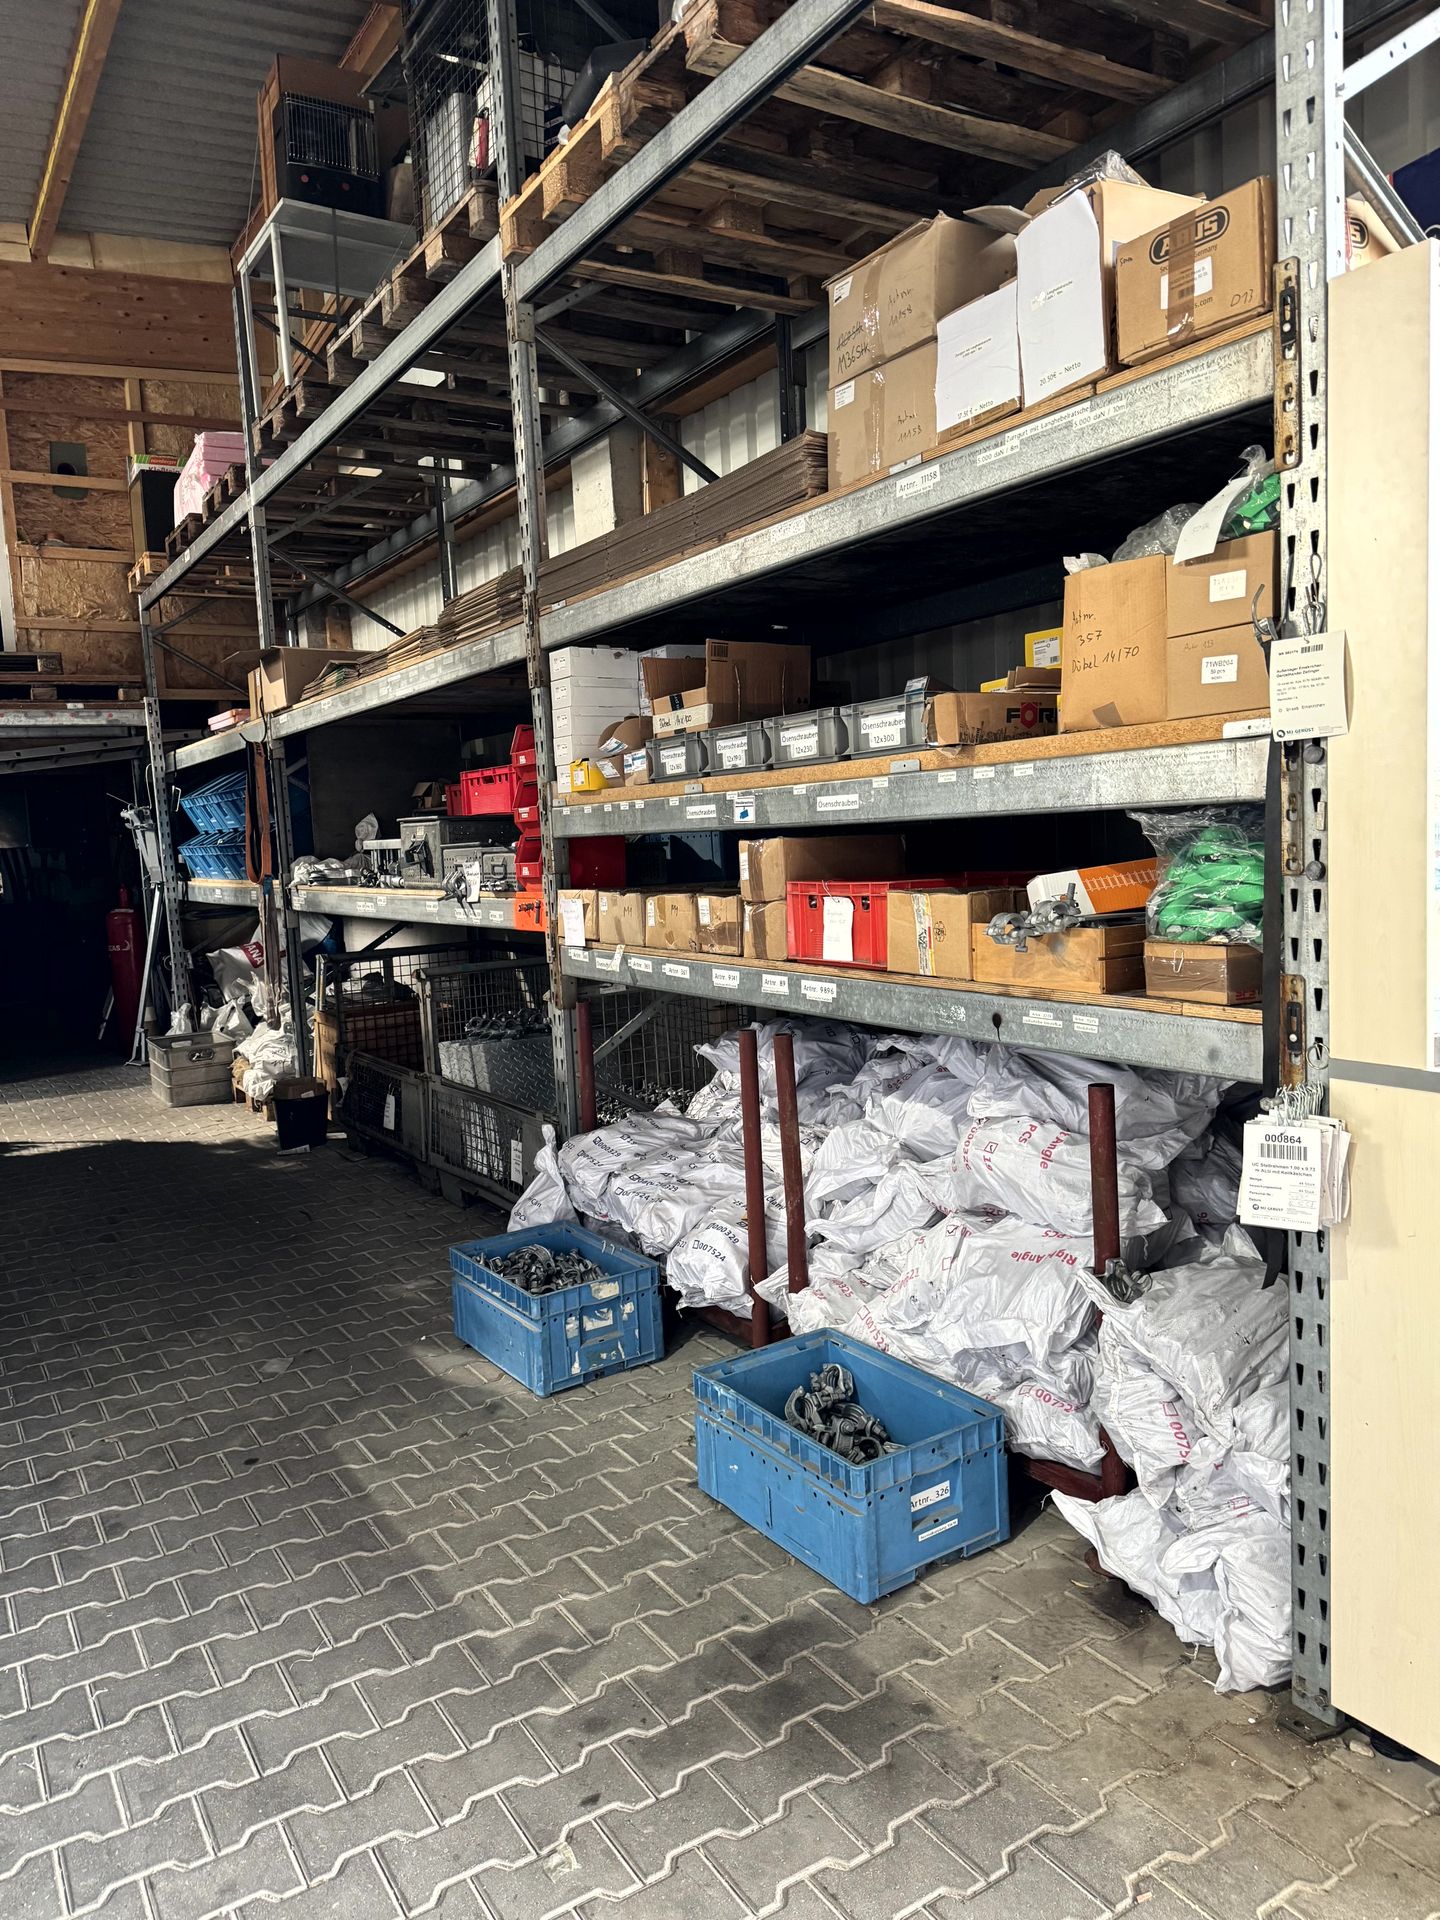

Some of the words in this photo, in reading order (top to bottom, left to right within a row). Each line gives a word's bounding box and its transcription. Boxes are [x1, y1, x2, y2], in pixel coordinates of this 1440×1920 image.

[1160, 214, 1218, 256] ABUS
[1064, 361, 1082, 373] Netto
[979, 400, 994, 411] Netto
[898, 477, 918, 493] Artnr.
[920, 470, 939, 486] 11158
[1077, 630, 1102, 646] 357
[1072, 654, 1099, 673] Dübel
[1006, 702, 1057, 728] FOR
[873, 734, 895, 744] 12x300
[795, 745, 813, 754] 12x230
[803, 984, 818, 993] Artnr.
[1018, 1123, 1038, 1144] PCS
[1264, 1133, 1302, 1145] 000864
[1040, 1136, 1065, 1170] Angle
[711, 1222, 740, 1246] 000329
[699, 1242, 726, 1263] 007524
[1011, 1250, 1048, 1265] Angle
[1169, 1420, 1192, 1464] 0075
[911, 1496, 932, 1509] Artnr.
[935, 1485, 950, 1499] 326
